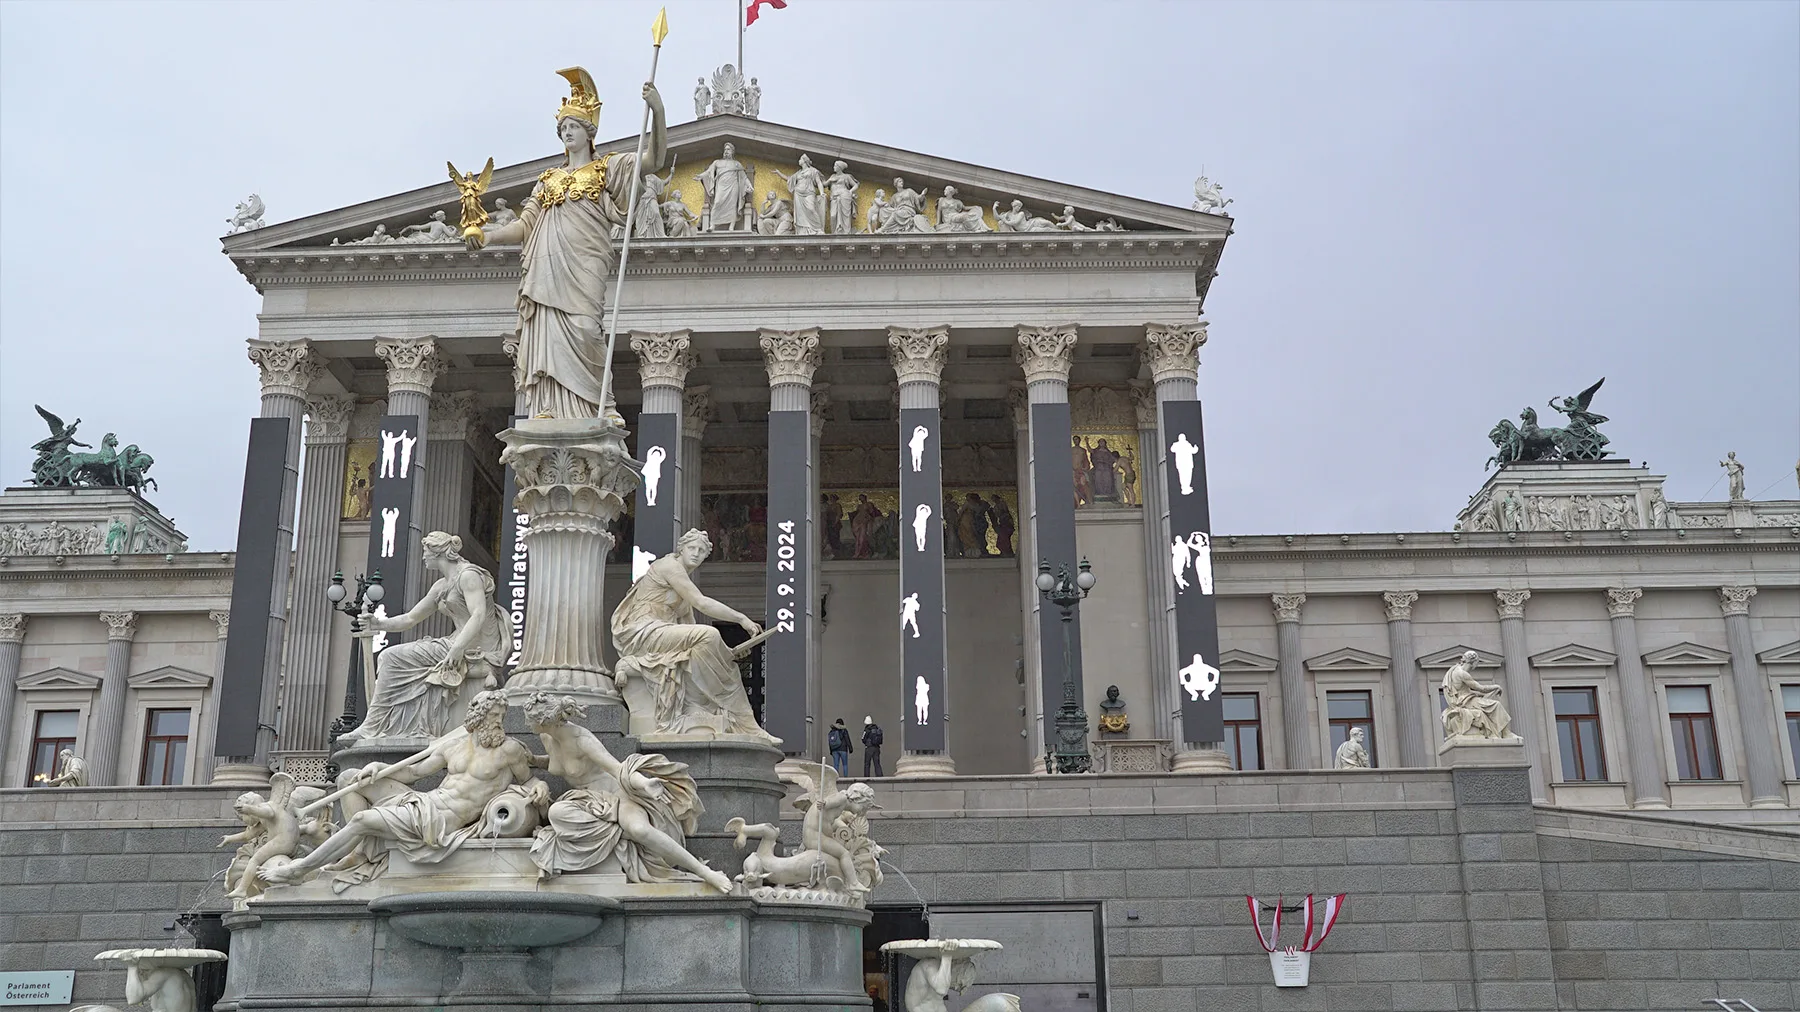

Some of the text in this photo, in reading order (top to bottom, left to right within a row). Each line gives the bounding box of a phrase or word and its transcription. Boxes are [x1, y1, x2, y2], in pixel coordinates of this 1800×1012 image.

[777, 520, 795, 572] 2024
[507, 508, 530, 666] Nationalratswa
[6, 991, 50, 999] Österreich
[7, 982, 51, 990] Parlament
